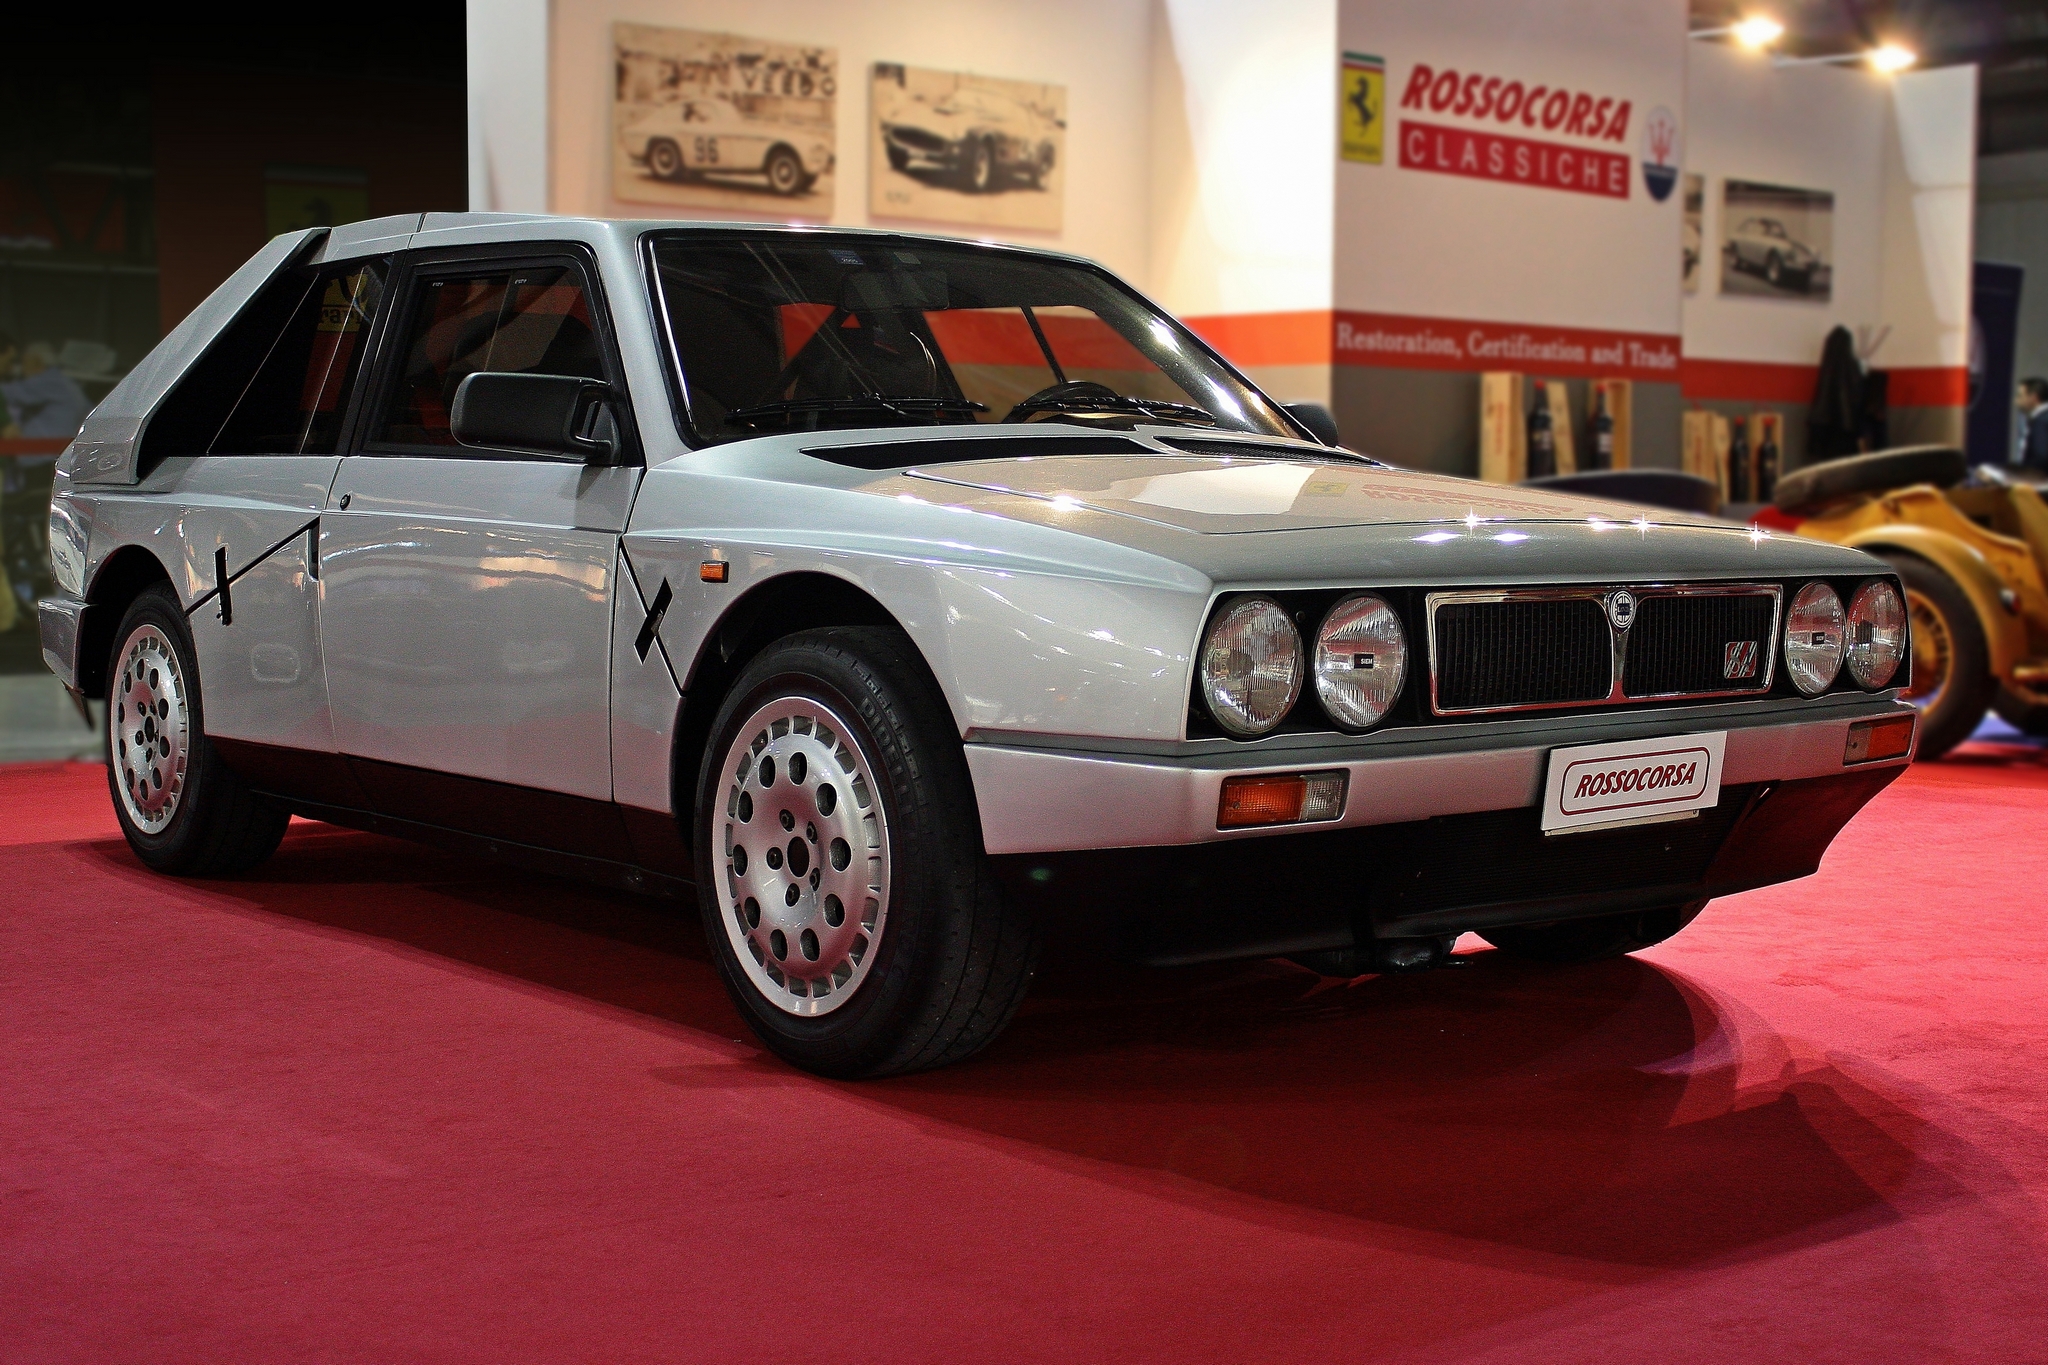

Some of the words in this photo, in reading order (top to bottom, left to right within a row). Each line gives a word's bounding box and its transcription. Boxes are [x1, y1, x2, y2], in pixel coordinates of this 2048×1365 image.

[1401, 64, 1631, 142] ROSSOCORSA
[1406, 130, 1624, 193] CLASSICHE
[1336, 321, 1463, 359] Restoration,
[1467, 330, 1586, 363] Certification
[1591, 342, 1624, 366] and
[1629, 341, 1677, 370] Trade
[1573, 761, 1698, 799] ROSSOCORSA
